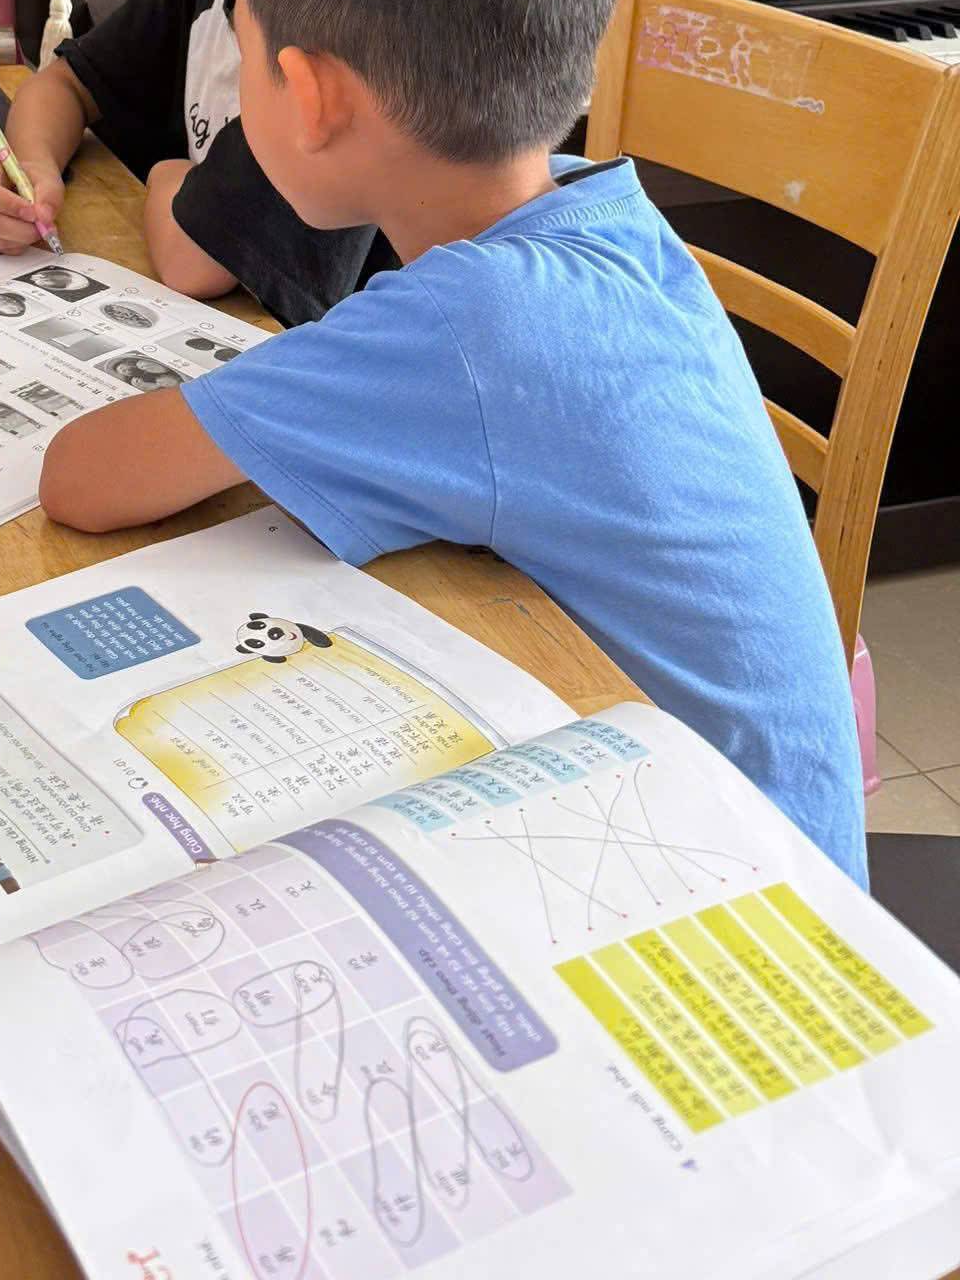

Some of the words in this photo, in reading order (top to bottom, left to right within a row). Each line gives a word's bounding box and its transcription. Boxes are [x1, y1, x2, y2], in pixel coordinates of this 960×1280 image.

[267, 786, 281, 796] 坐
[231, 793, 253, 814] 可以
[163, 810, 186, 829] học
[3, 825, 20, 839] câu
[178, 826, 205, 855] Cùng
[15, 838, 38, 862] Những
